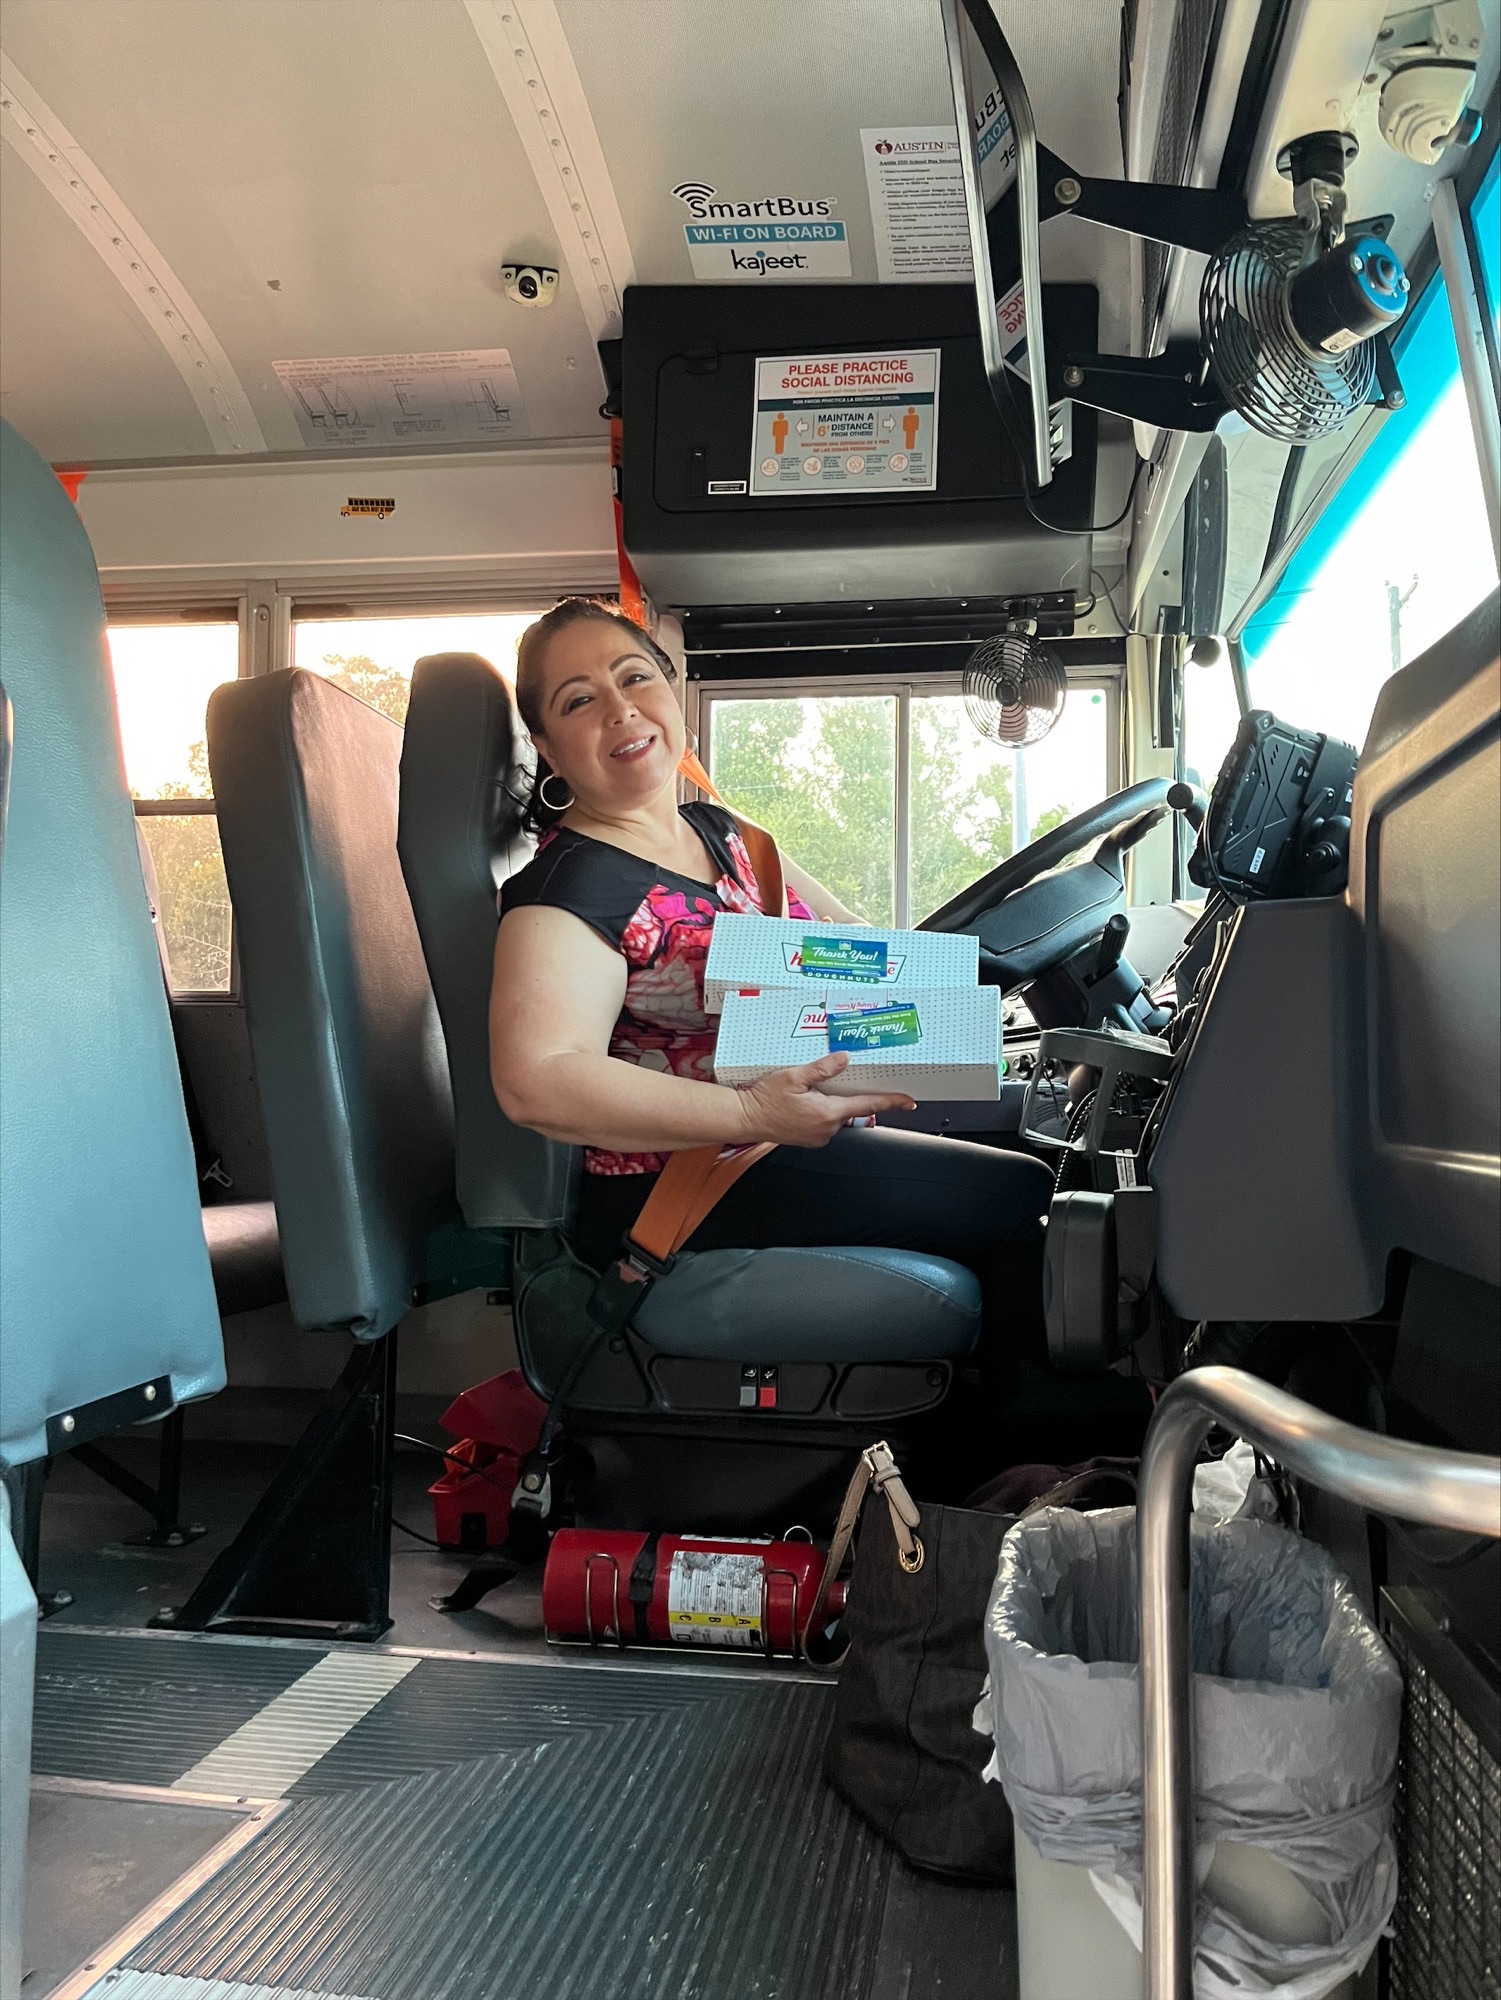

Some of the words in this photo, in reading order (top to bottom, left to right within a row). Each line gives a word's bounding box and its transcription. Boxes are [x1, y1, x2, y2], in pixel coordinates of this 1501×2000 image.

[894, 142, 944, 151] AUSTIN
[690, 198, 830, 218] SmartBus
[694, 227, 738, 240] WI-FI
[743, 227, 770, 240] ON
[774, 226, 837, 239] BOARD
[789, 363, 839, 376] PLEASE
[842, 360, 908, 373] PRACTICE
[782, 374, 830, 388] SOCIAL
[834, 372, 914, 386] DISTANCING
[818, 413, 864, 422] MAINTAIN
[831, 423, 874, 431] DISTANCE
[812, 946, 848, 959] Thank
[850, 950, 878, 962] You!
[808, 972, 875, 983] DOUGHNUTS
[839, 1024, 868, 1041] You!
[870, 1022, 907, 1035] Thank
